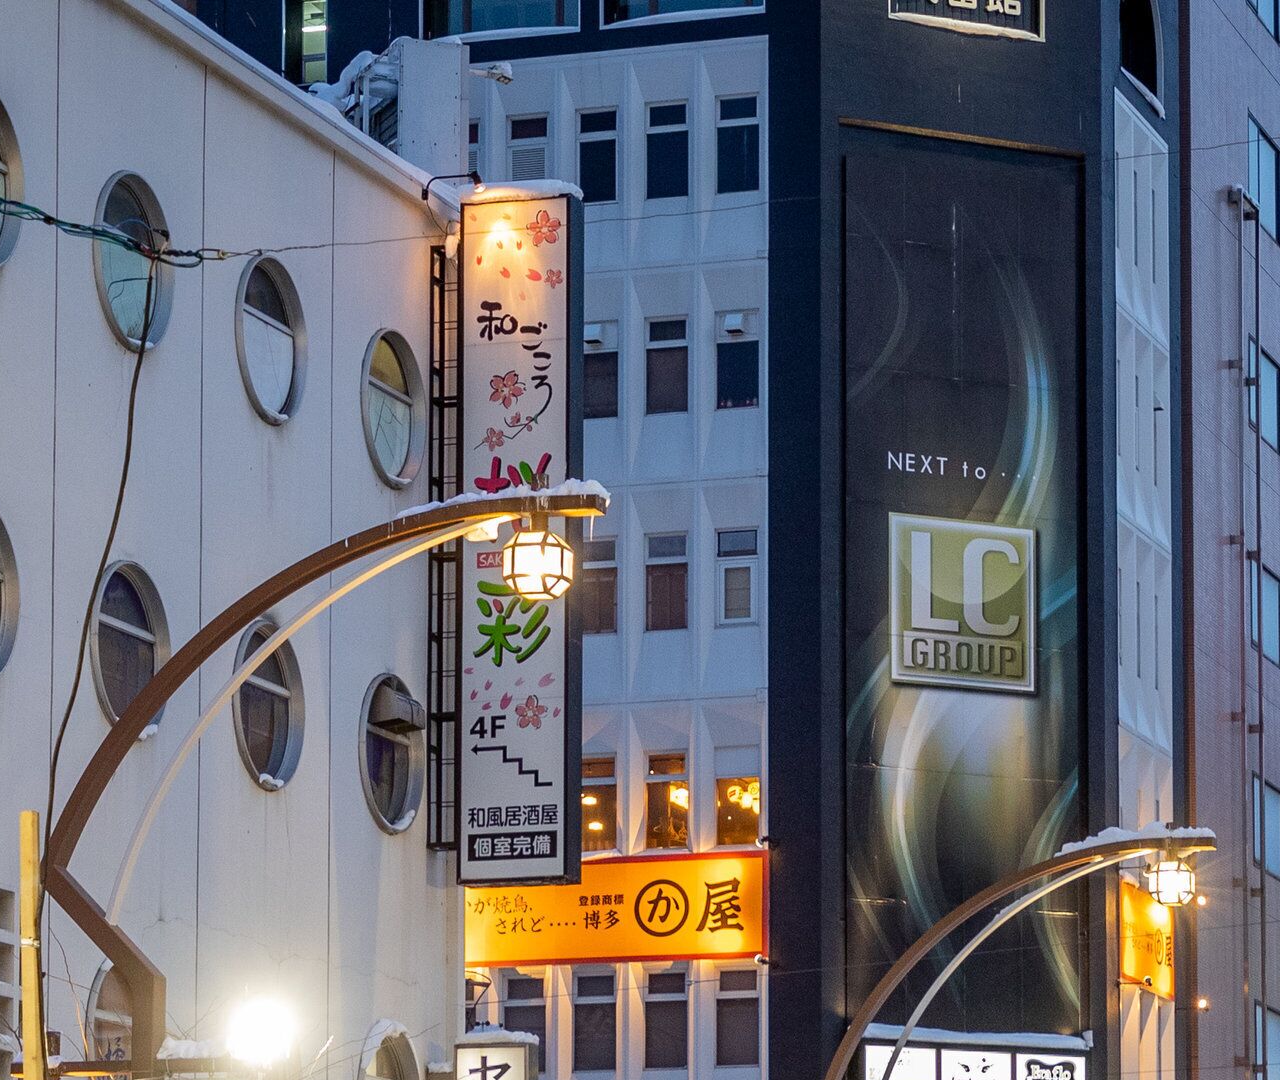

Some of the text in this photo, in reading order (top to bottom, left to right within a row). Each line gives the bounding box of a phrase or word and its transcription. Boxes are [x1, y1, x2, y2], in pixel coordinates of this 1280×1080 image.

[477, 300, 552, 418] 和ごころ
[887, 451, 987, 480] NEXT to
[910, 531, 1021, 635] LC
[911, 637, 1018, 678] GROUP
[470, 715, 507, 739] 4F
[468, 804, 559, 829] 和風居酒屋
[473, 834, 552, 857] 個室完備
[467, 893, 533, 915] が焼鳥、
[578, 894, 625, 907] 登録商標
[583, 909, 621, 930] 博多
